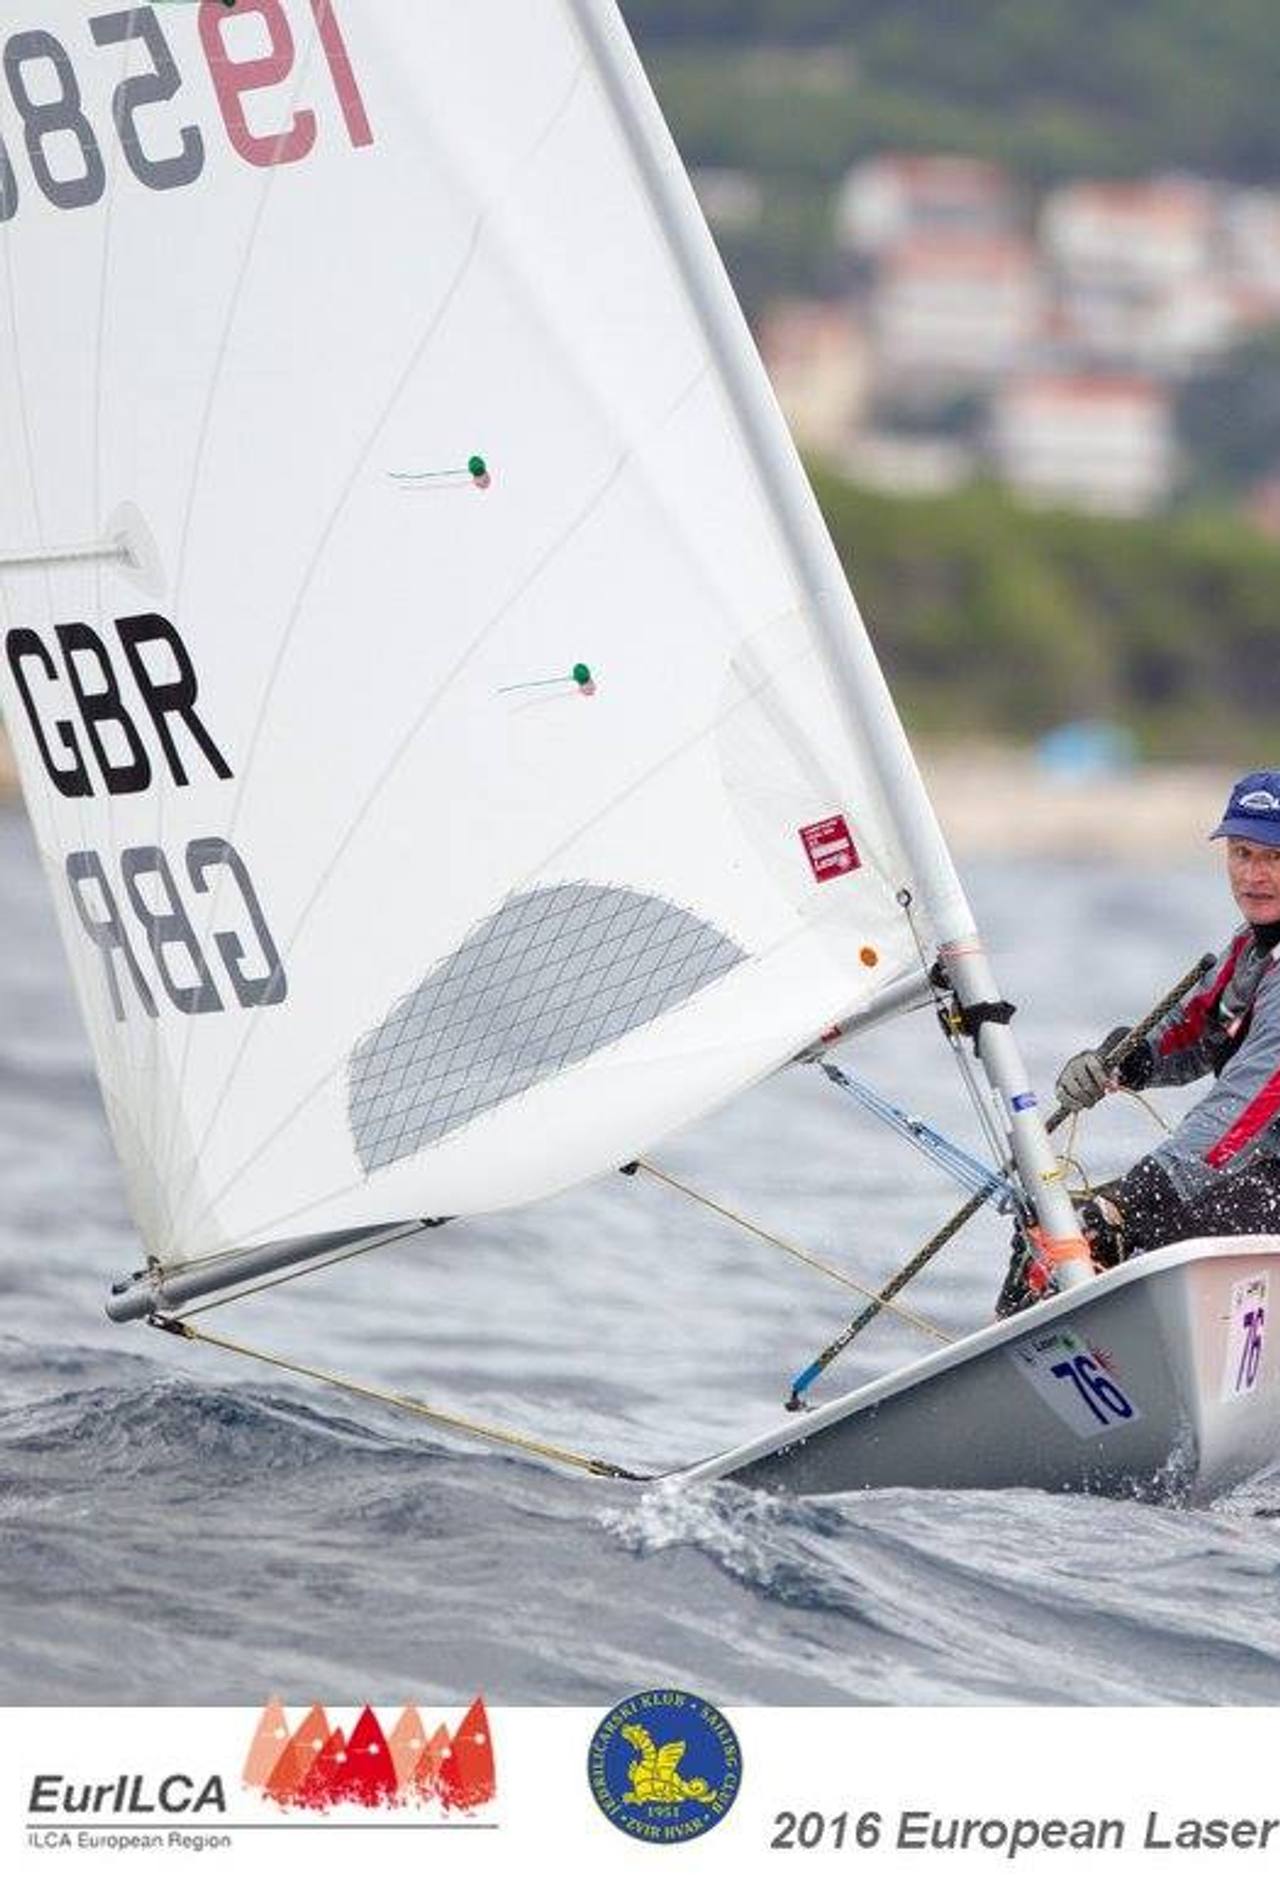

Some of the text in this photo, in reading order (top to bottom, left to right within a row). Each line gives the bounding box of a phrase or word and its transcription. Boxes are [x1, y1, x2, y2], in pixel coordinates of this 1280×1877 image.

[5, 612, 234, 798] GBR
[1051, 1355, 1132, 1425] 76
[1235, 1307, 1265, 1392] 76
